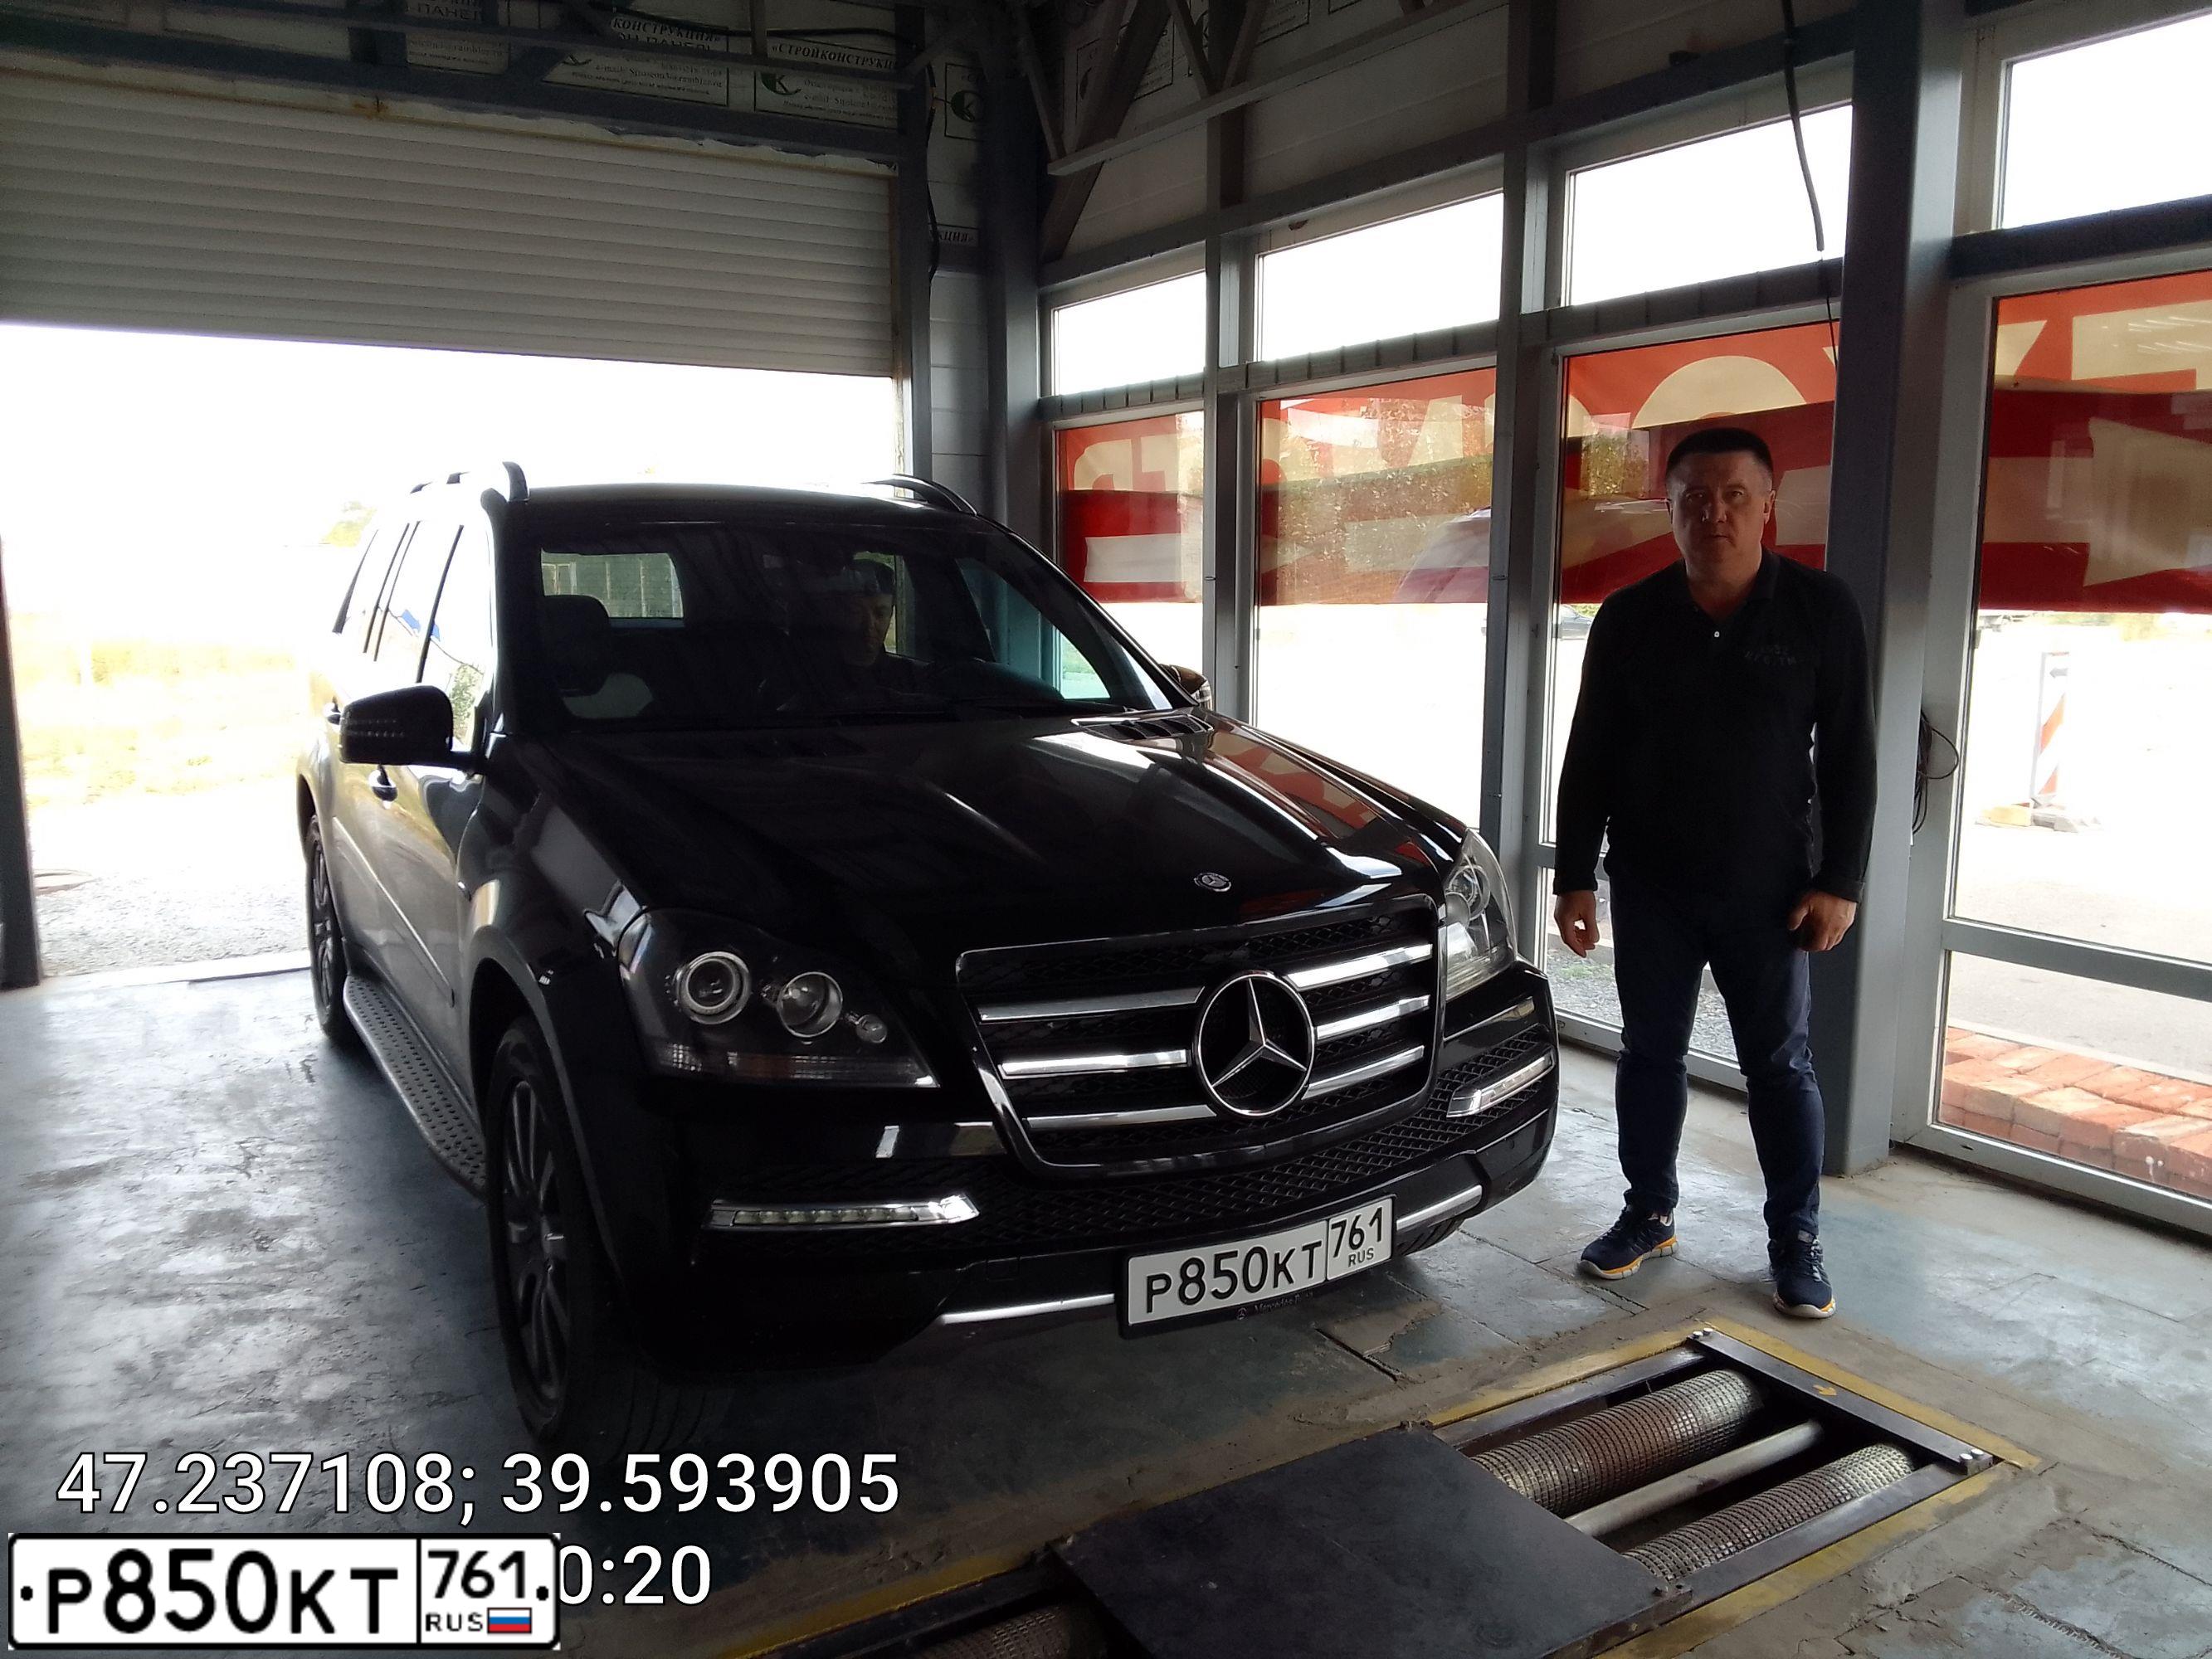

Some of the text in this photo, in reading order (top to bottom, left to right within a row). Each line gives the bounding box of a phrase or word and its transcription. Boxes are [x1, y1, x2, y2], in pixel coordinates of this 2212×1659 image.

[1146, 1206, 1384, 1314] Р850КТ 761
[1347, 1248, 1375, 1267] RUS
